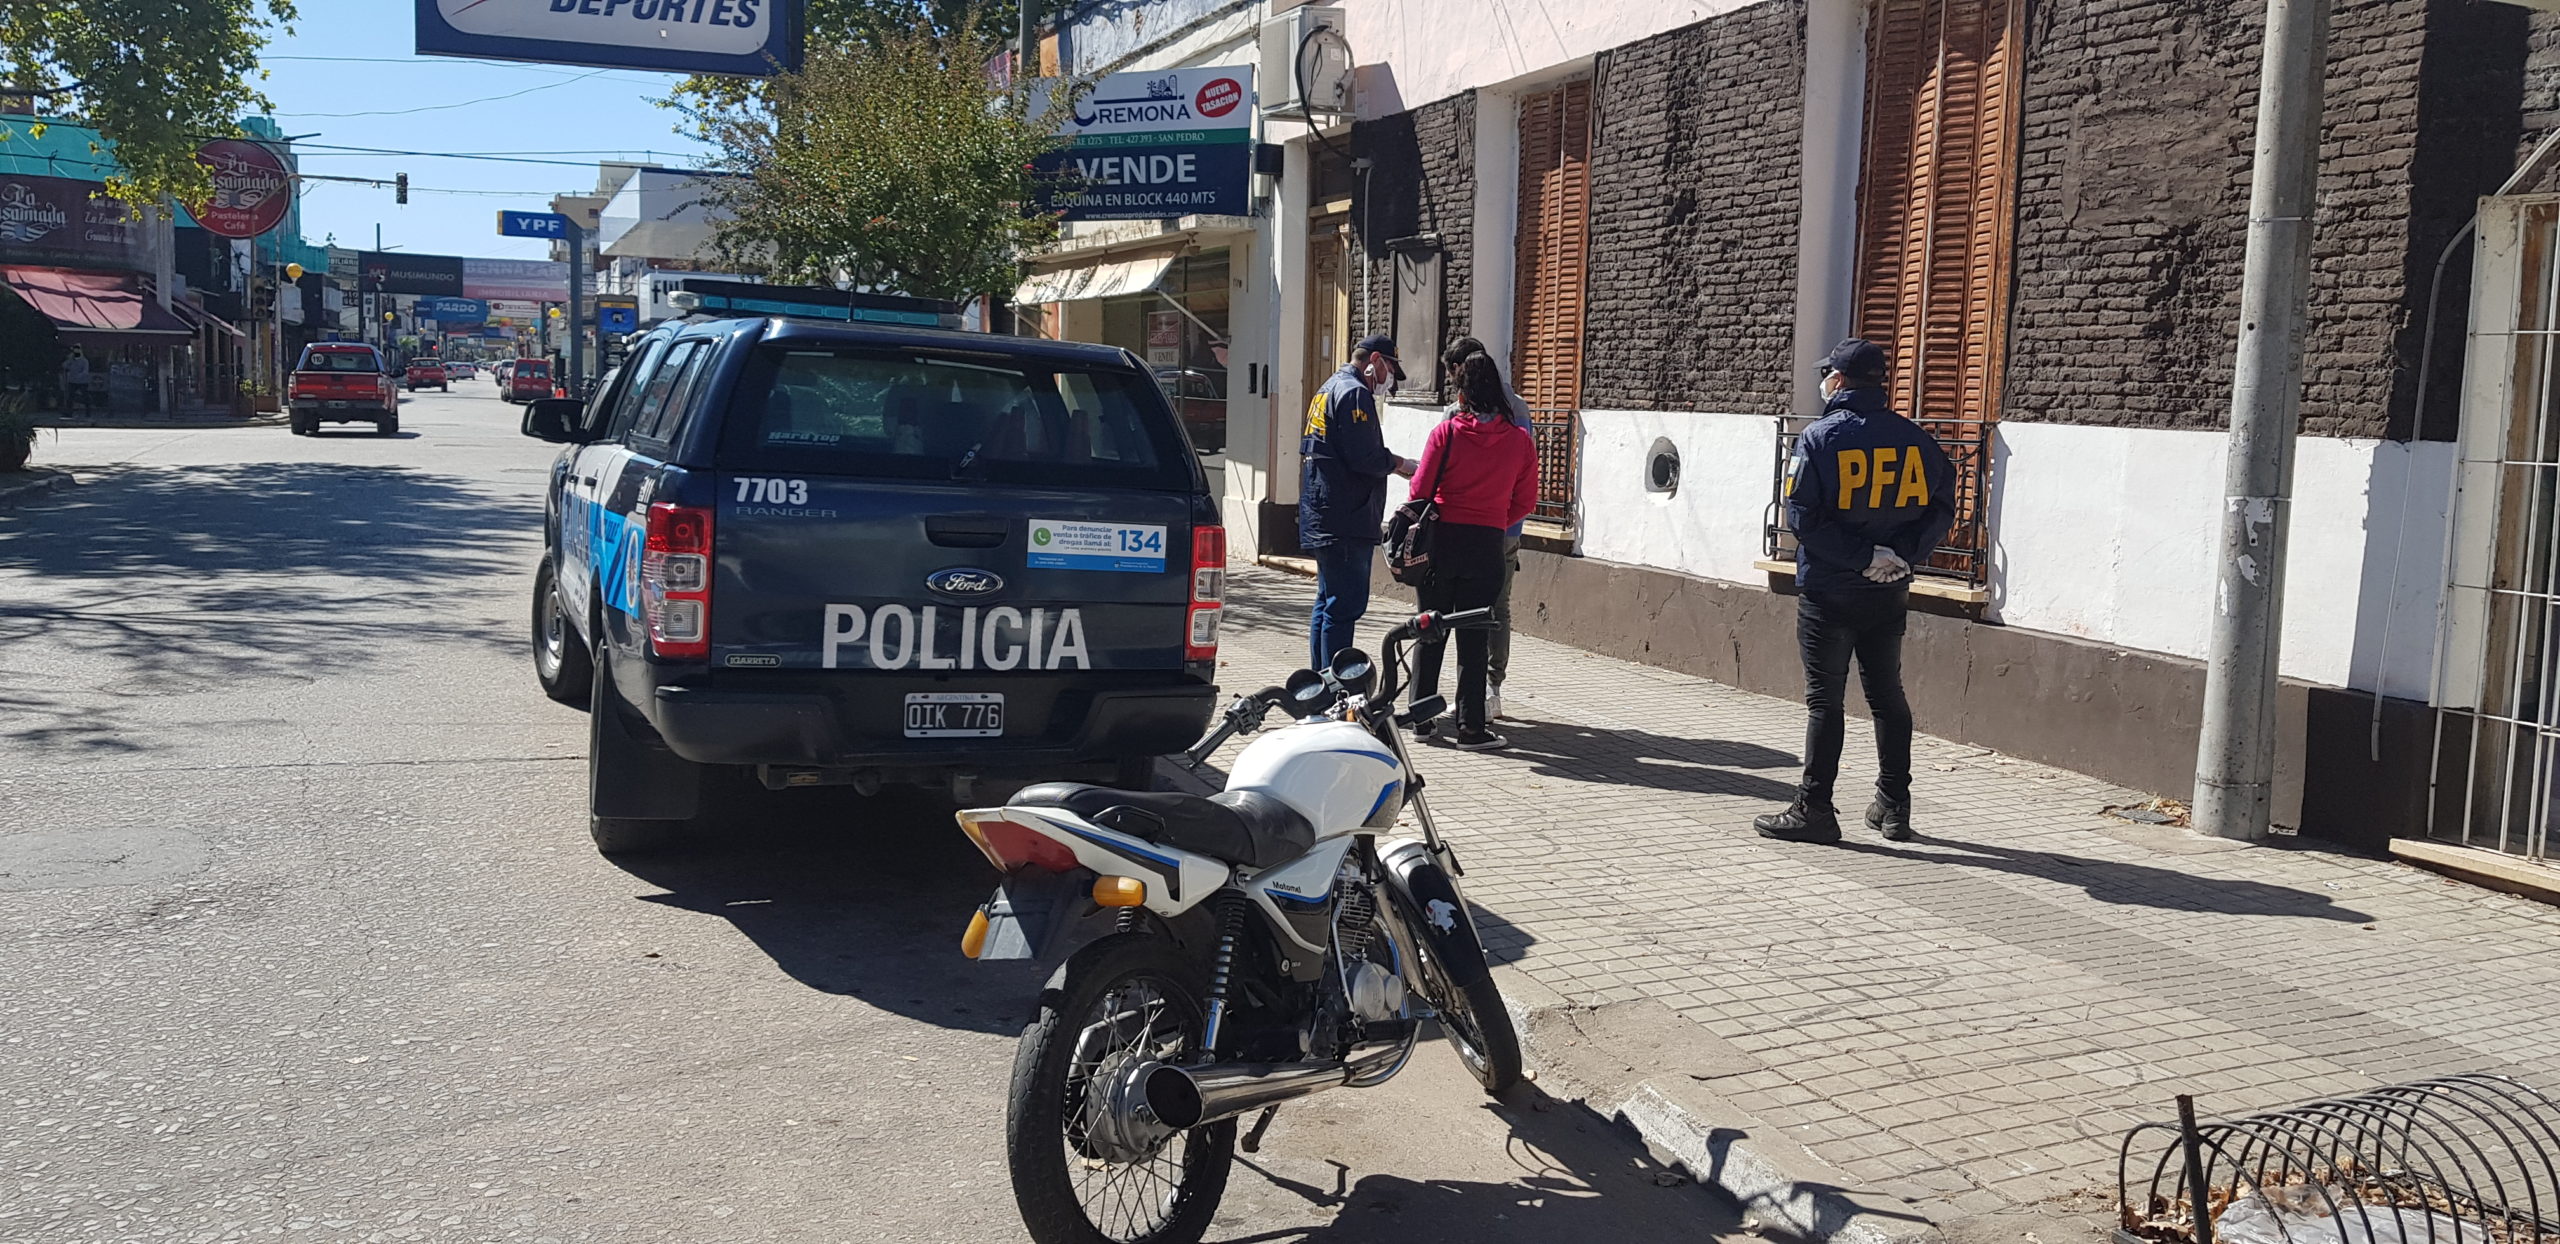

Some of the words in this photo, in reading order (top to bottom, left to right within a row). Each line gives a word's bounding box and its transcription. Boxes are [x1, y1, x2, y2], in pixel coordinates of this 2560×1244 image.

[1204, 82, 1231, 98] NUEVA
[1071, 82, 1191, 127] CREMONA
[1201, 92, 1239, 113] TASACION
[1158, 133, 1174, 143] SAN
[1175, 132, 1205, 143] PEDRO
[1075, 153, 1197, 186] VENDE
[1, 183, 35, 209] La
[1051, 193, 1102, 208] ESQUINA
[1106, 193, 1122, 206] EN
[1124, 192, 1163, 206] BLOCK
[1165, 191, 1188, 205] 440
[1191, 191, 1215, 204] MTS
[211, 210, 258, 221] Pastelera
[517, 217, 561, 232] YPF
[390, 270, 455, 282] MUSIMUNDO
[436, 301, 477, 313] PARDO
[1837, 445, 1929, 510] PFA
[733, 477, 808, 506] 7703
[736, 506, 837, 518] RANGER
[1062, 524, 1078, 532] Para
[1079, 525, 1112, 533] denunciar
[1059, 539, 1082, 547] drogas
[1117, 529, 1162, 553] 134
[944, 573, 990, 592] Ford
[821, 602, 1092, 672] POLICIA
[729, 656, 778, 666] IGARRETA
[908, 703, 947, 729] OIK
[960, 703, 1000, 729] 776
